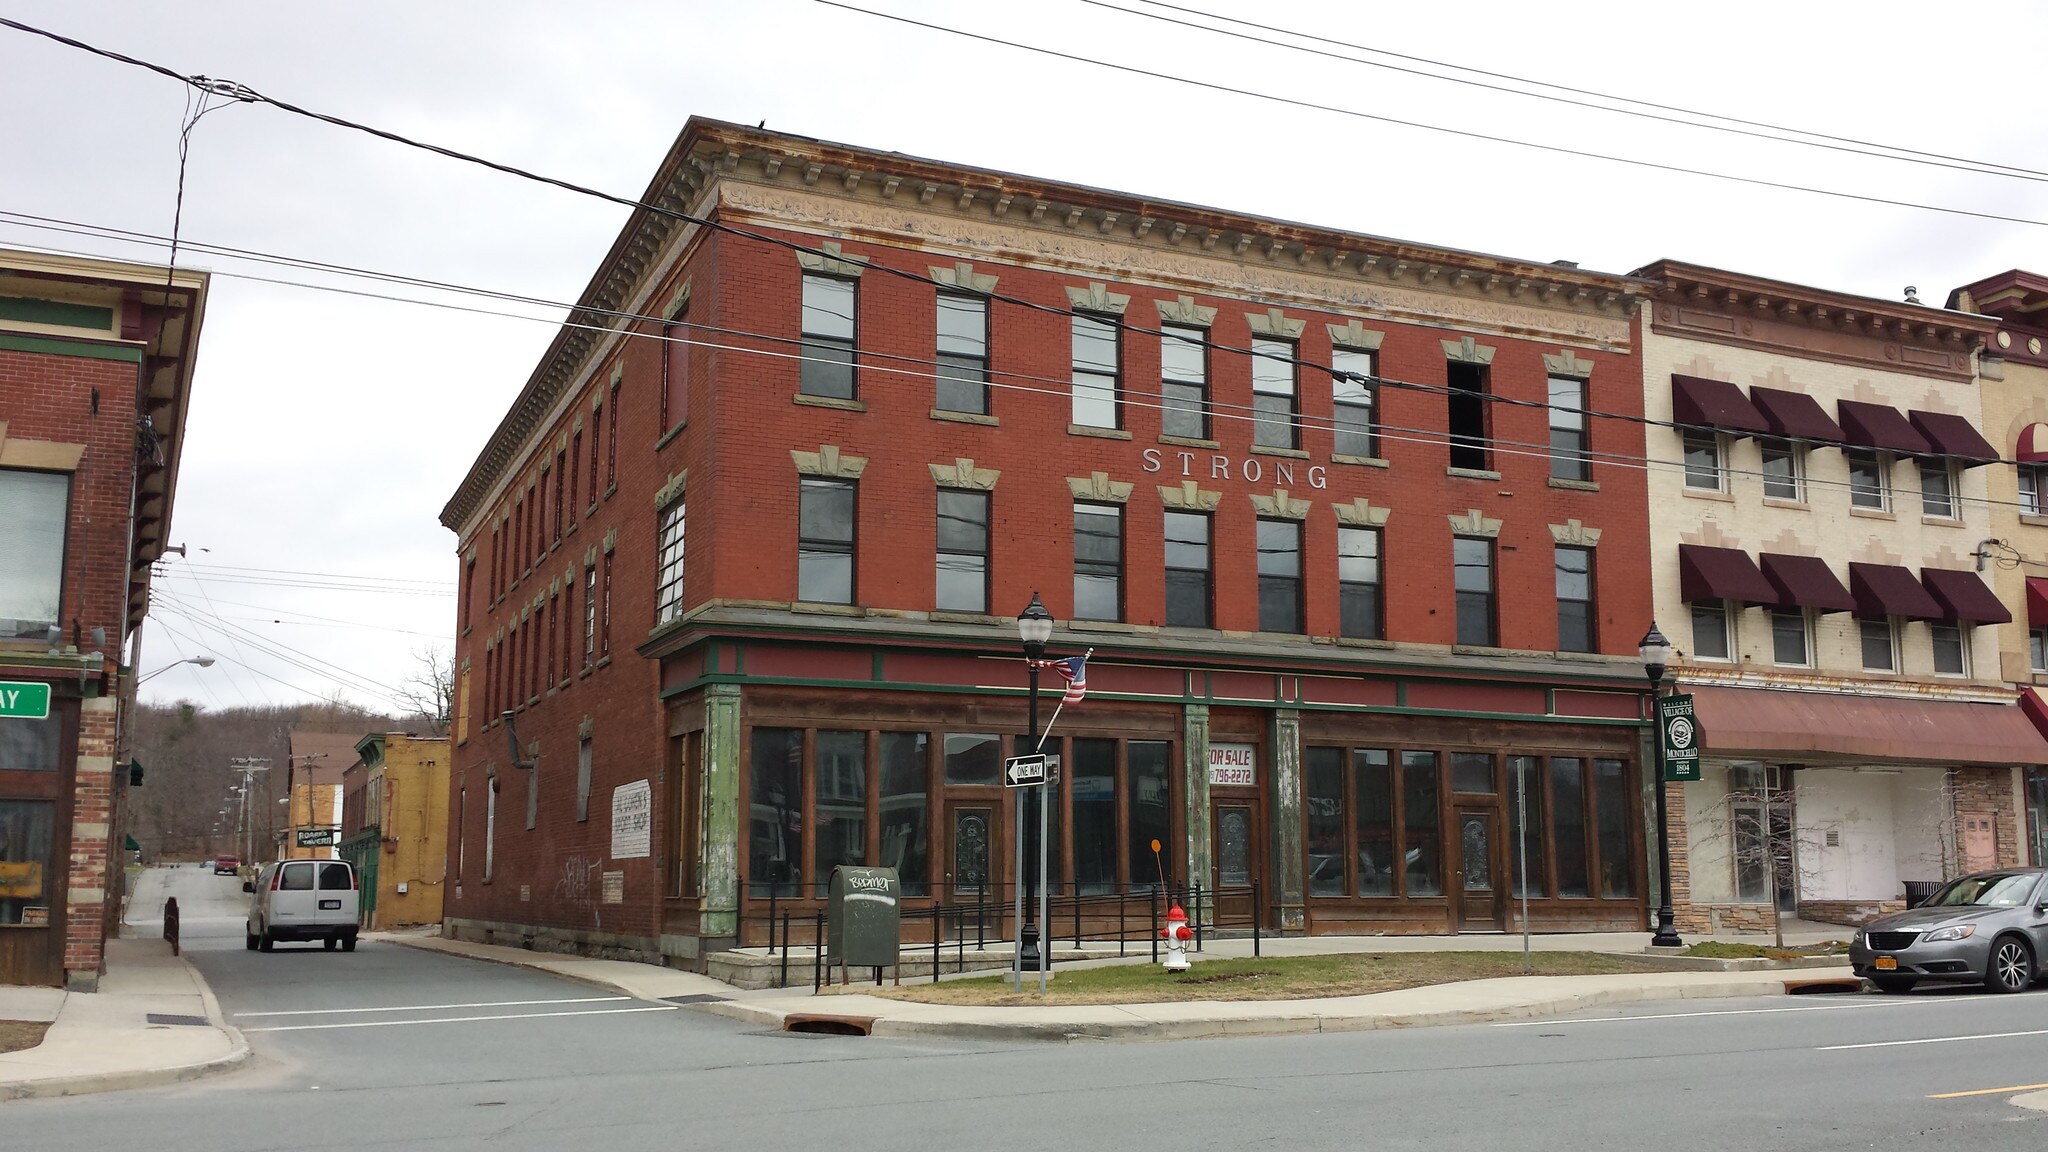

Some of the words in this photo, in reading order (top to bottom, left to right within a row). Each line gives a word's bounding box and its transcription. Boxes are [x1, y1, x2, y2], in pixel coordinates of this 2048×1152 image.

[1142, 448, 1327, 489] STRONG
[1663, 708, 1685, 717] VILLAGE
[1685, 706, 1693, 715] OF
[1225, 750, 1250, 766] SALE
[1666, 747, 1698, 758] MONTICELLO
[1017, 764, 1029, 777] ONE
[1030, 763, 1042, 776] WAY
[1676, 764, 1690, 772] 1804
[1215, 768, 1251, 783] 796-2272
